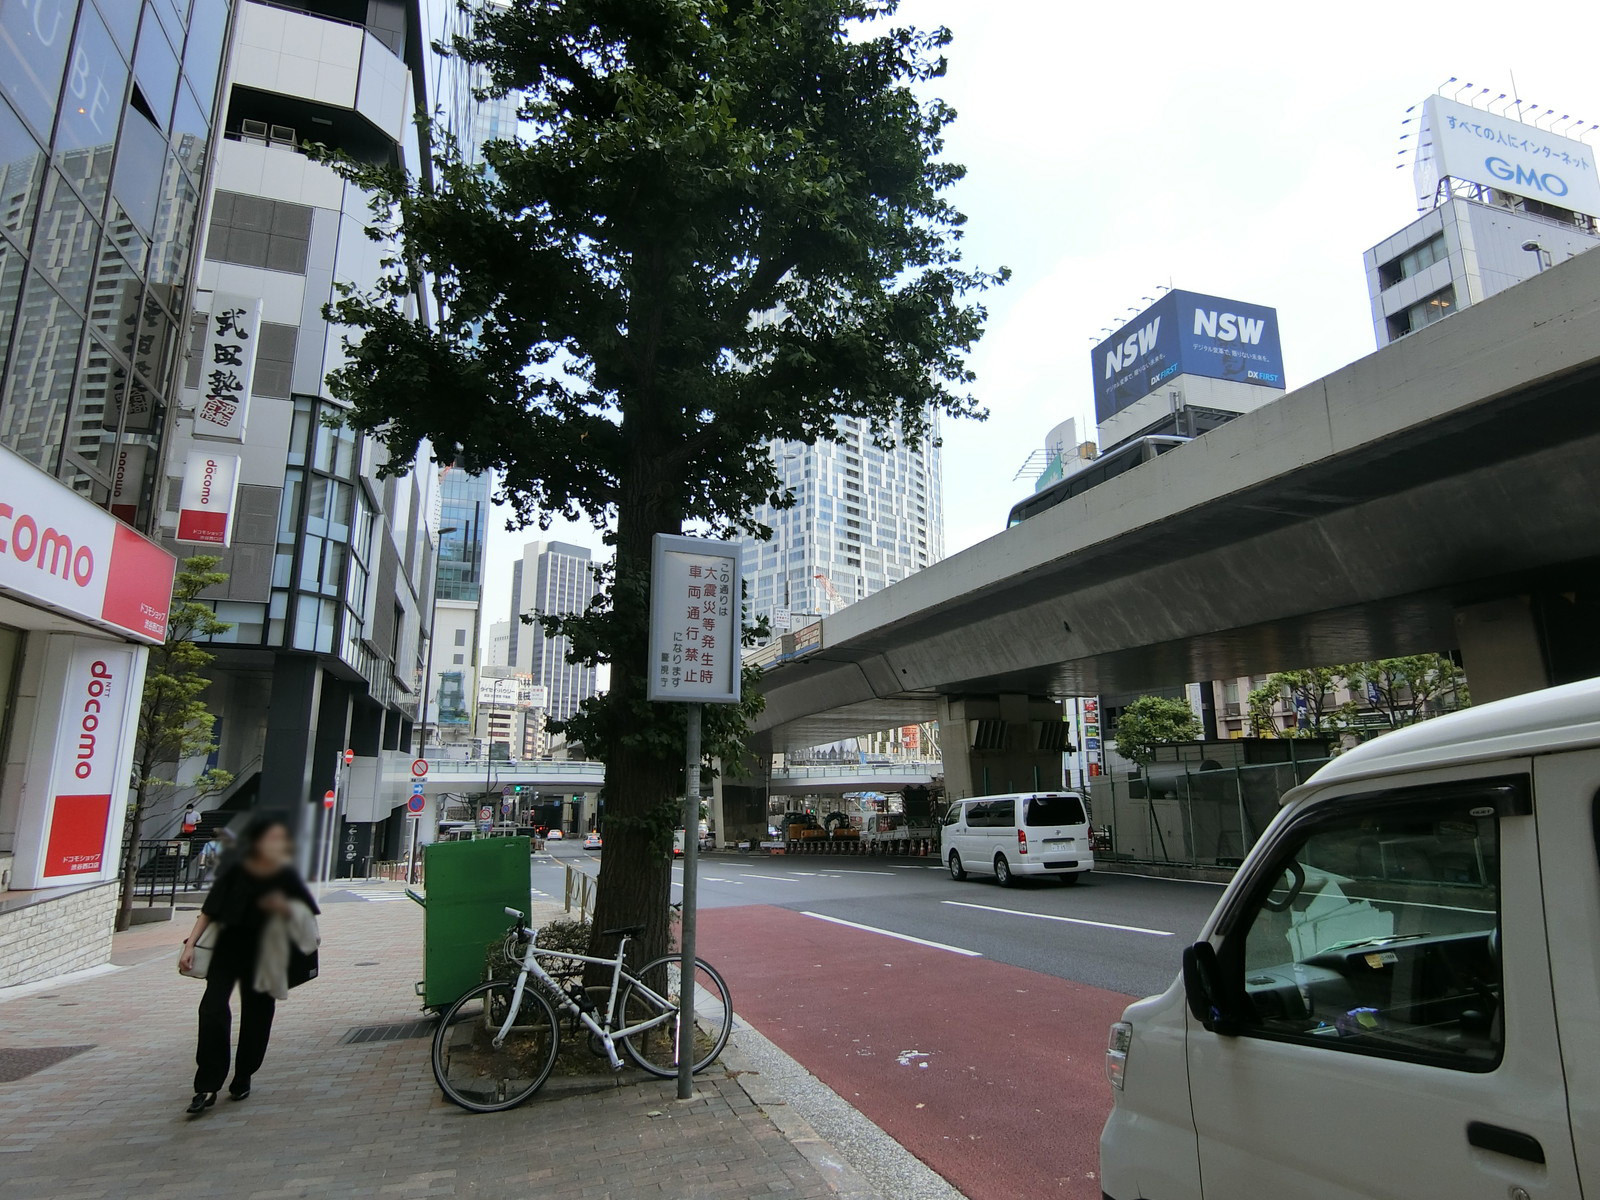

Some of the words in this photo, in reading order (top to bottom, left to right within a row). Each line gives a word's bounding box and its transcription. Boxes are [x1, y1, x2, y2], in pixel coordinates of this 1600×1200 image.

[1446, 115, 1589, 170] すべての人にインターネット
[1484, 156, 1568, 197] GMO
[1105, 316, 1161, 380] NSW
[1193, 308, 1265, 345] NSW
[206, 308, 249, 403] 武田塾
[1247, 370, 1258, 379] DX
[1258, 372, 1278, 382] FIRST
[201, 459, 217, 505] docomo
[718, 563, 730, 617] この通りは
[684, 565, 702, 683] 車両通行禁止
[700, 567, 718, 684] 大震災等発生時
[672, 632, 683, 688] になります
[75, 660, 112, 780] docomo
[62, 853, 101, 863] ドコモショップ
